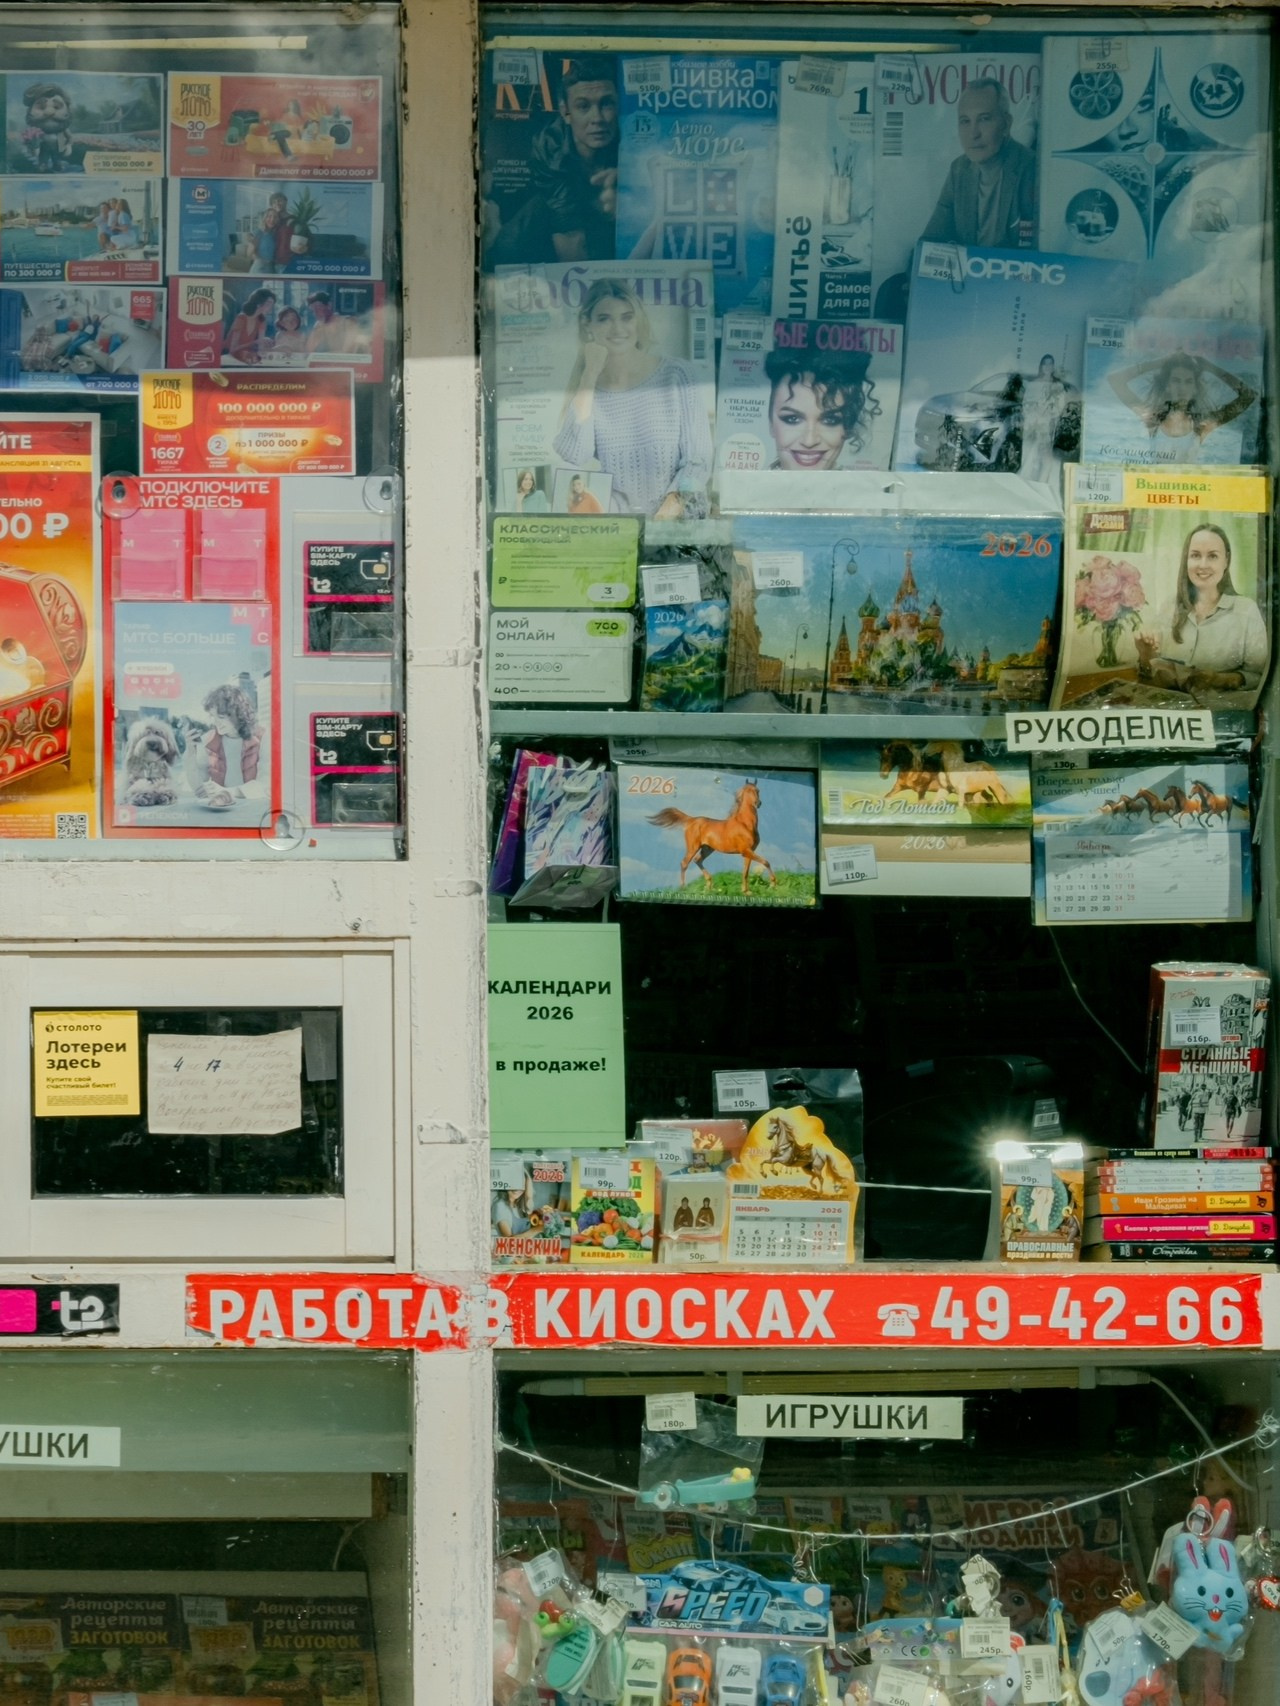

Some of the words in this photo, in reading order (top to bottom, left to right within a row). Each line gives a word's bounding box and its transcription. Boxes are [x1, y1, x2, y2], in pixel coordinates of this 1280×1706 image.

[1096, 62, 1118, 70] 255р.
[672, 67, 755, 88] шивка
[640, 84, 663, 93] 510р.
[854, 86, 871, 114] 1
[669, 120, 716, 136] Лето,
[668, 135, 749, 160] море,
[966, 256, 1066, 286] OPPING
[825, 282, 870, 294] Самое
[824, 297, 850, 309] для
[816, 324, 896, 353] СОВЕТЫ
[741, 341, 762, 350] 242р.
[237, 383, 306, 391] РАСПРЕДЕЛИМ
[150, 447, 184, 458] 1667
[729, 451, 760, 461] ЛЕТО
[725, 462, 737, 470] НА
[739, 462, 759, 470] ДАЧЕ
[141, 481, 269, 494] ПОДКЛЮЧИТЕ
[1135, 478, 1211, 492] Вышивка:
[182, 495, 243, 508] ЗДЕСЬ
[1088, 493, 1111, 501] 120р.
[1146, 494, 1199, 505] ЦВЕТЫ
[500, 522, 620, 535] КЛАССИЧЕСКИЙ
[980, 533, 1052, 557] 2026
[770, 579, 793, 588] 260р.
[497, 617, 529, 628] МОЙ
[654, 611, 684, 624] 2026
[496, 630, 555, 641] ОНЛАЙН
[1013, 716, 1205, 744] РУКОДЕЛИЕ
[1053, 761, 1078, 769] 130р.
[628, 775, 675, 795] 2026
[1037, 776, 1082, 789] Впереди
[1087, 775, 1126, 786] только
[1042, 787, 1075, 797] самое
[889, 799, 957, 817] Лошади
[901, 836, 946, 850] 2026
[845, 871, 868, 880] 110р.
[488, 980, 612, 997] КАЛЕНДАРИ
[527, 1006, 574, 1021] 2026
[56, 1024, 102, 1032] СТОЛОТО
[1187, 1034, 1211, 1044] 616р.
[46, 1041, 127, 1056] Лотереи
[1181, 1047, 1251, 1061] СТРАННЫЕ
[46, 1058, 101, 1070] здесь
[174, 1056, 184, 1072] 4
[206, 1059, 221, 1072] 17
[496, 1060, 506, 1071] в
[513, 1058, 606, 1074] продаже!
[1180, 1061, 1252, 1075] ЖЕНЩИНЫ
[733, 1100, 758, 1109] 105р.
[659, 1153, 682, 1162] 120р.
[533, 1169, 563, 1182] 2026
[1021, 1175, 1039, 1184] 99р.
[492, 1181, 511, 1190] 99р.
[597, 1180, 616, 1188] 99р.
[496, 1237, 561, 1256] ЖЕНСКИЙ
[1007, 1241, 1074, 1252] ПРАВОСЛАВНЫЕ
[209, 1288, 451, 1339] РАБОТА
[487, 1288, 510, 1339] В
[536, 1288, 835, 1339] КИОСКАХ
[930, 1287, 1244, 1341] 49-42-66
[766, 1404, 929, 1430] ИГРУШКИ
[663, 1420, 687, 1429] 180р.
[61, 1598, 166, 1614] Авторские
[71, 1614, 164, 1629] рецепты
[70, 1631, 168, 1645] ЗАГОТОВОК
[262, 1635, 360, 1649] ЗАГОТОВОК
[1152, 1632, 1171, 1652] 170р.
[980, 1646, 1004, 1655] 245р.
[1023, 1670, 1032, 1691] 160р.
